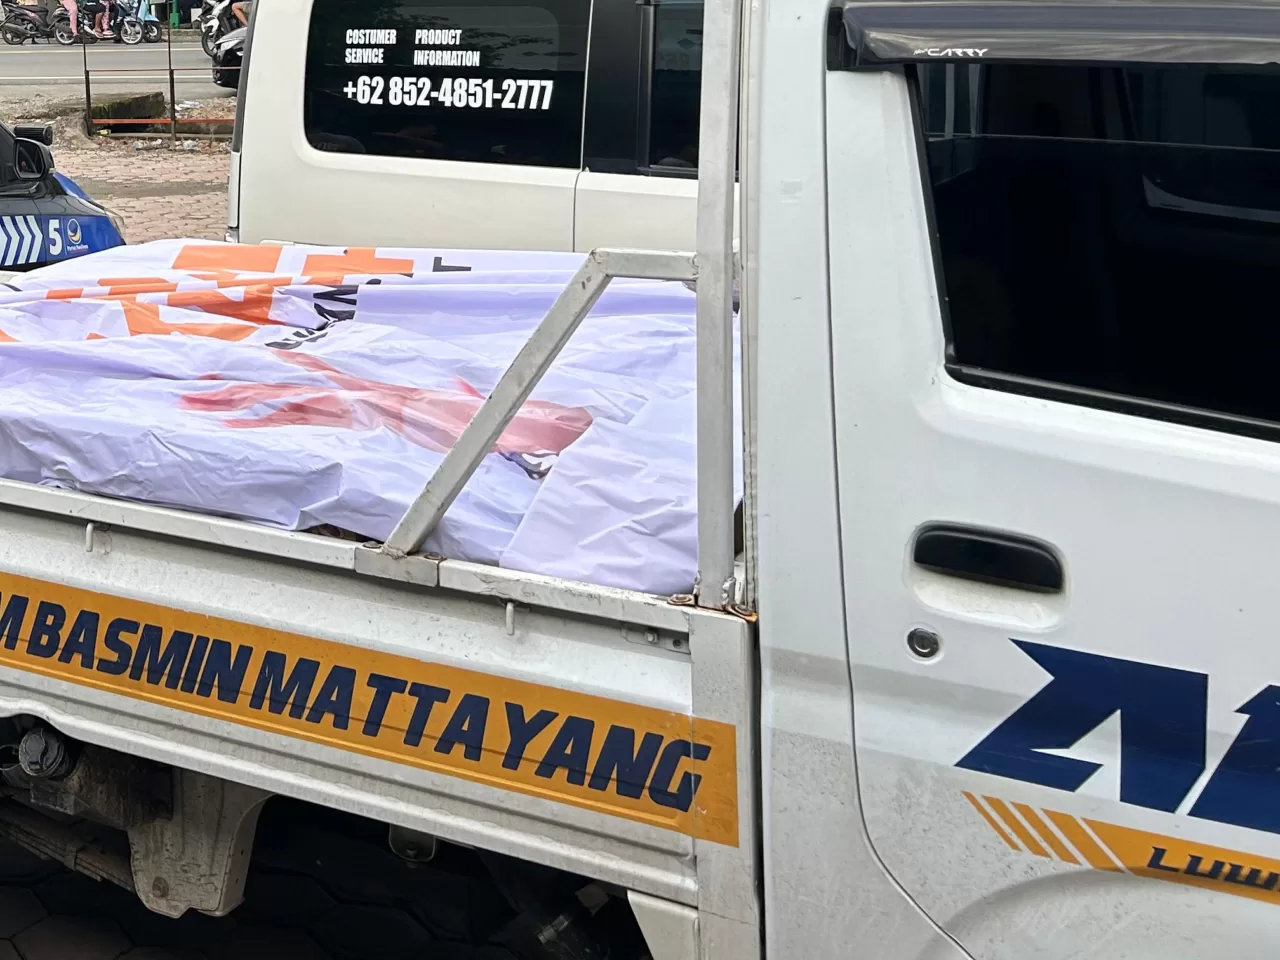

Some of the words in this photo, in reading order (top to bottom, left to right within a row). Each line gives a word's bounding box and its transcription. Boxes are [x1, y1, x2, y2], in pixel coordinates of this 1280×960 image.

[346, 29, 397, 44] COSTUMER
[415, 29, 462, 45] PRODUCT
[345, 48, 384, 64] SERVICE
[413, 50, 481, 67] INFORMATION
[927, 48, 988, 57] CARRY
[343, 75, 385, 105] +62
[388, 76, 554, 110] 852-4851-2777
[48, 218, 63, 256] 5
[26, 597, 254, 706] BASMIN
[249, 648, 713, 814] MATTAYANG
